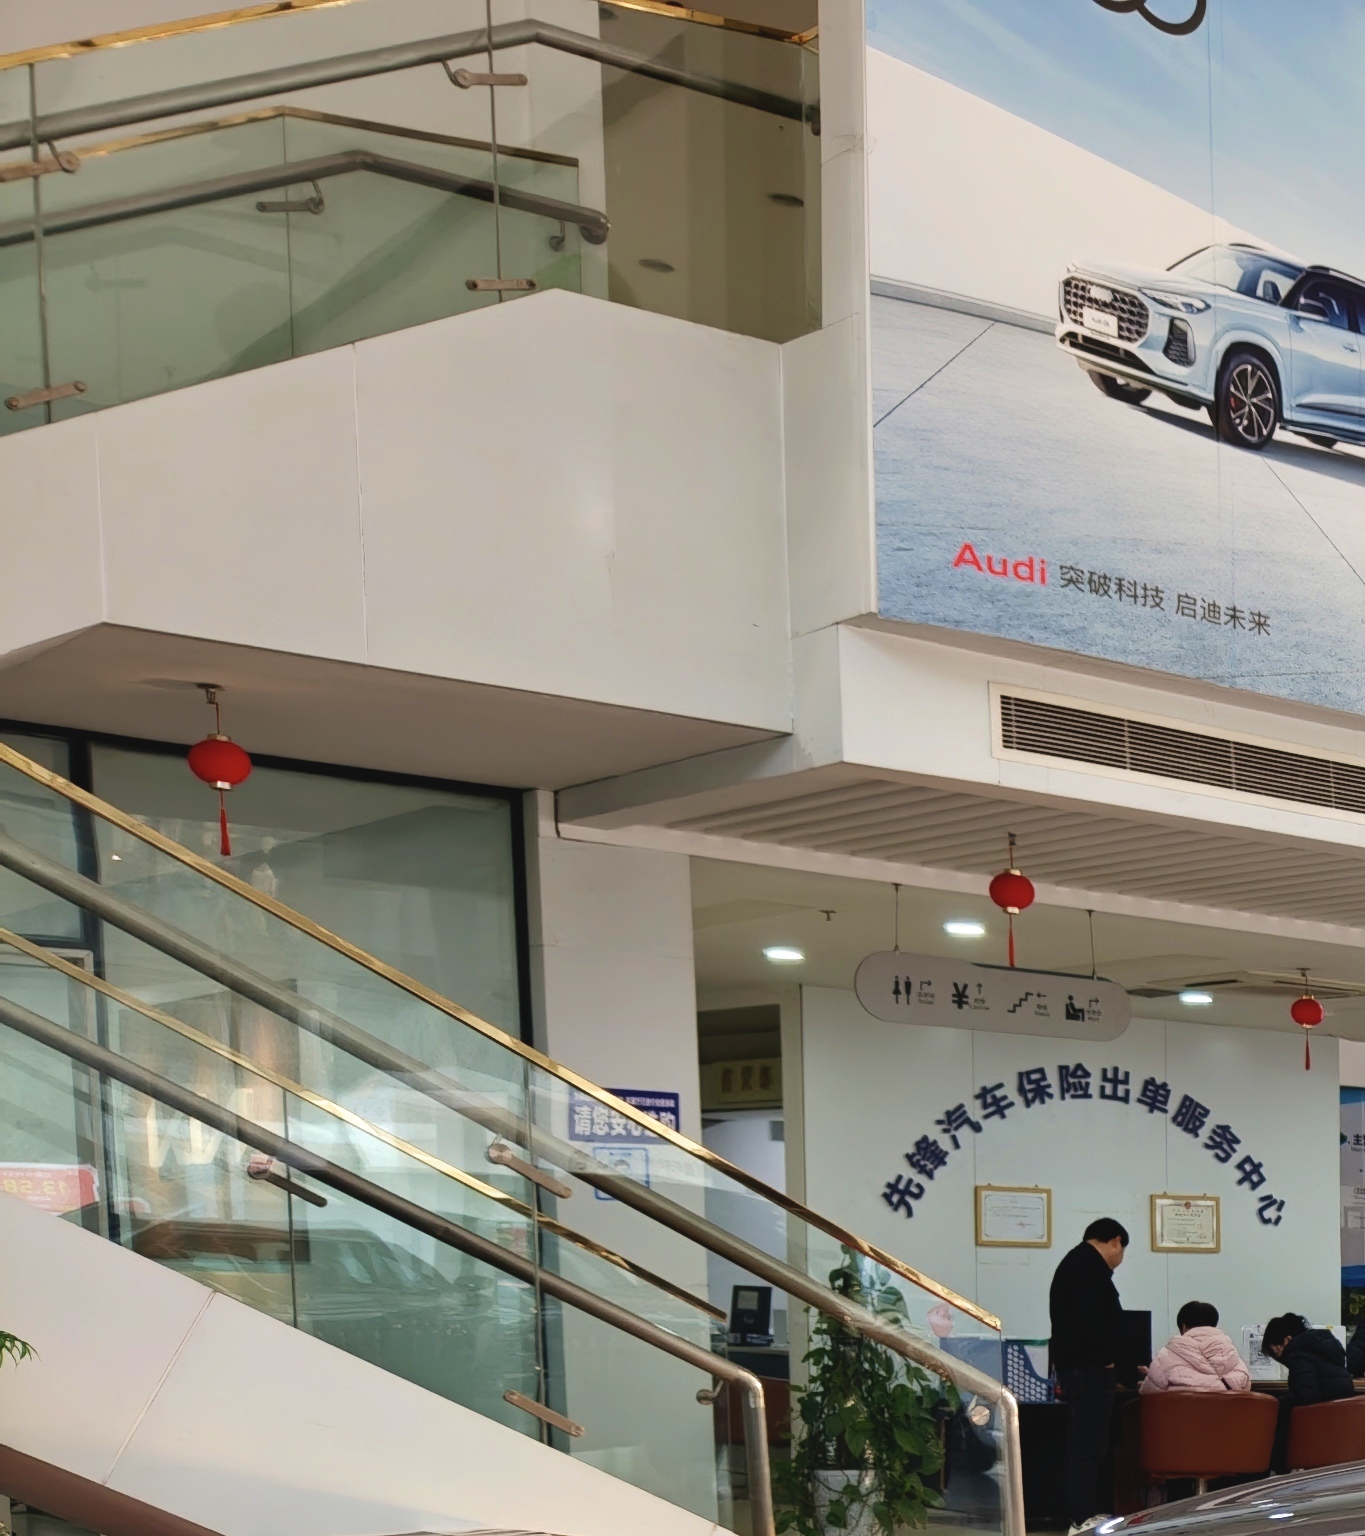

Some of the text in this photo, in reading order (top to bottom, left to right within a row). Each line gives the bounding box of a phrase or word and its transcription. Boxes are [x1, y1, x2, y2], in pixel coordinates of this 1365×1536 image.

[952, 542, 1272, 636] Audi 突破科技 启迪未来
[573, 1105, 677, 1137] 请您安心购
[881, 1062, 1287, 1229] 先锋汽车保险出单服务中心
